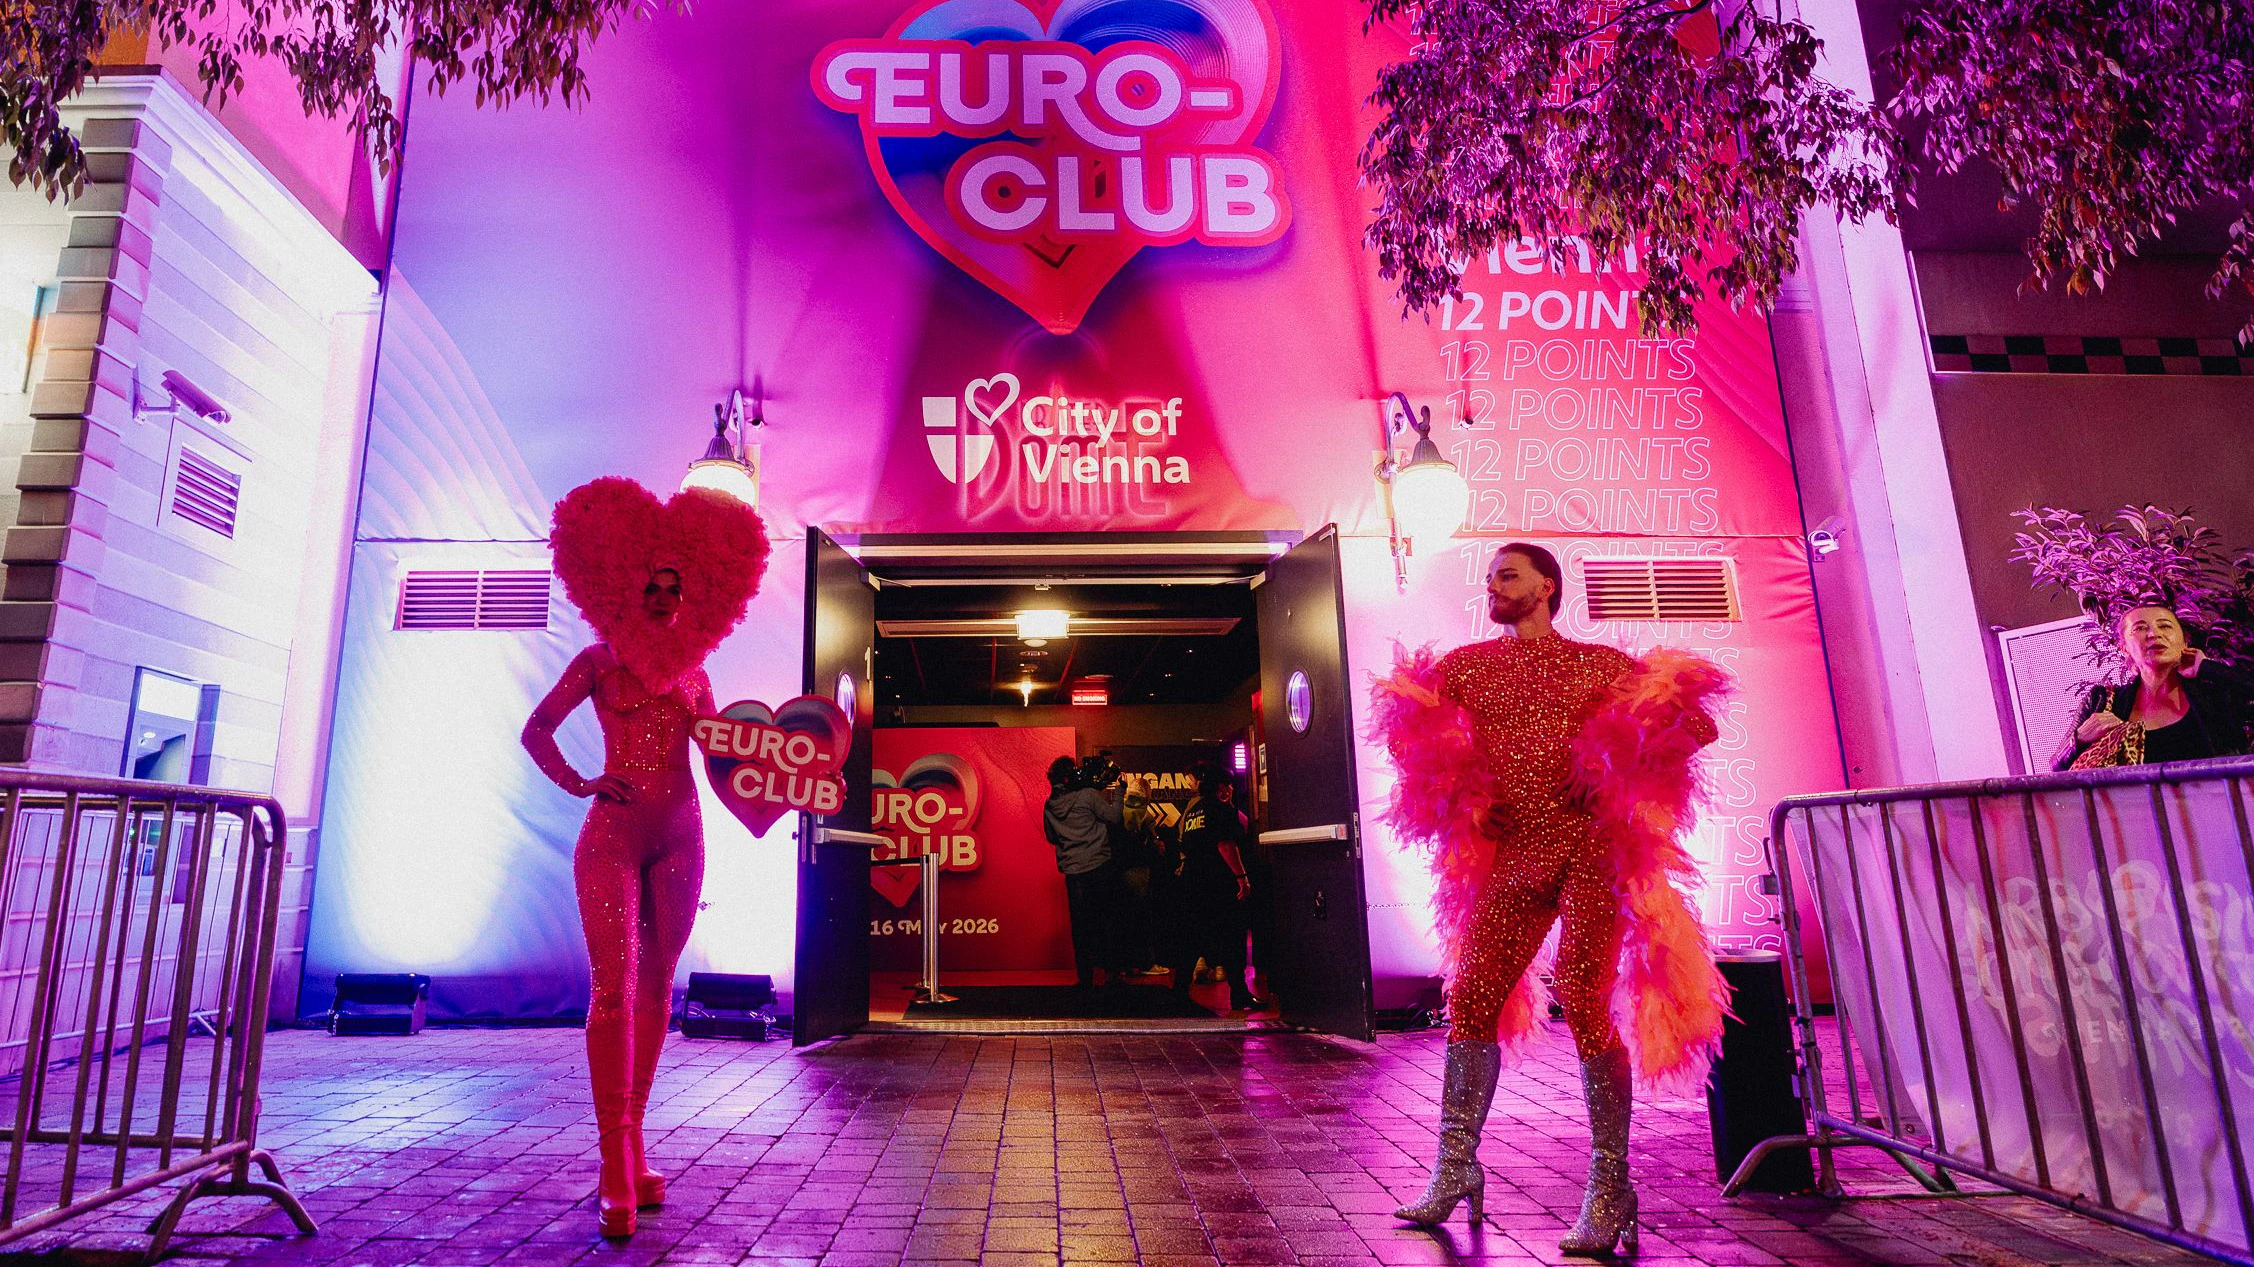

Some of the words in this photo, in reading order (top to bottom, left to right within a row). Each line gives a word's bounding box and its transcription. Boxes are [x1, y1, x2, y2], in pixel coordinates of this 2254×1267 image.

[826, 51, 1228, 151] EURO-
[961, 155, 1276, 234] CLUB
[1436, 226, 1672, 275] ienn
[1439, 291, 1484, 331] 12
[1498, 290, 1645, 331] POIN
[1440, 340, 1490, 381] 12
[1504, 339, 1697, 381] POINTS
[1022, 396, 1118, 447] City
[1132, 397, 1182, 436] of
[1446, 388, 1496, 430] 12
[1509, 387, 1703, 430] POINTS
[1022, 443, 1190, 484] Vienna
[1451, 438, 1501, 481] 12
[1515, 437, 1711, 481] POINTS
[1521, 488, 1719, 533] POINTS
[694, 719, 831, 774] EURO-
[732, 768, 839, 811] CLUB
[870, 919, 894, 936] 16
[897, 918, 948, 935] MY
[952, 917, 999, 934] 2026
